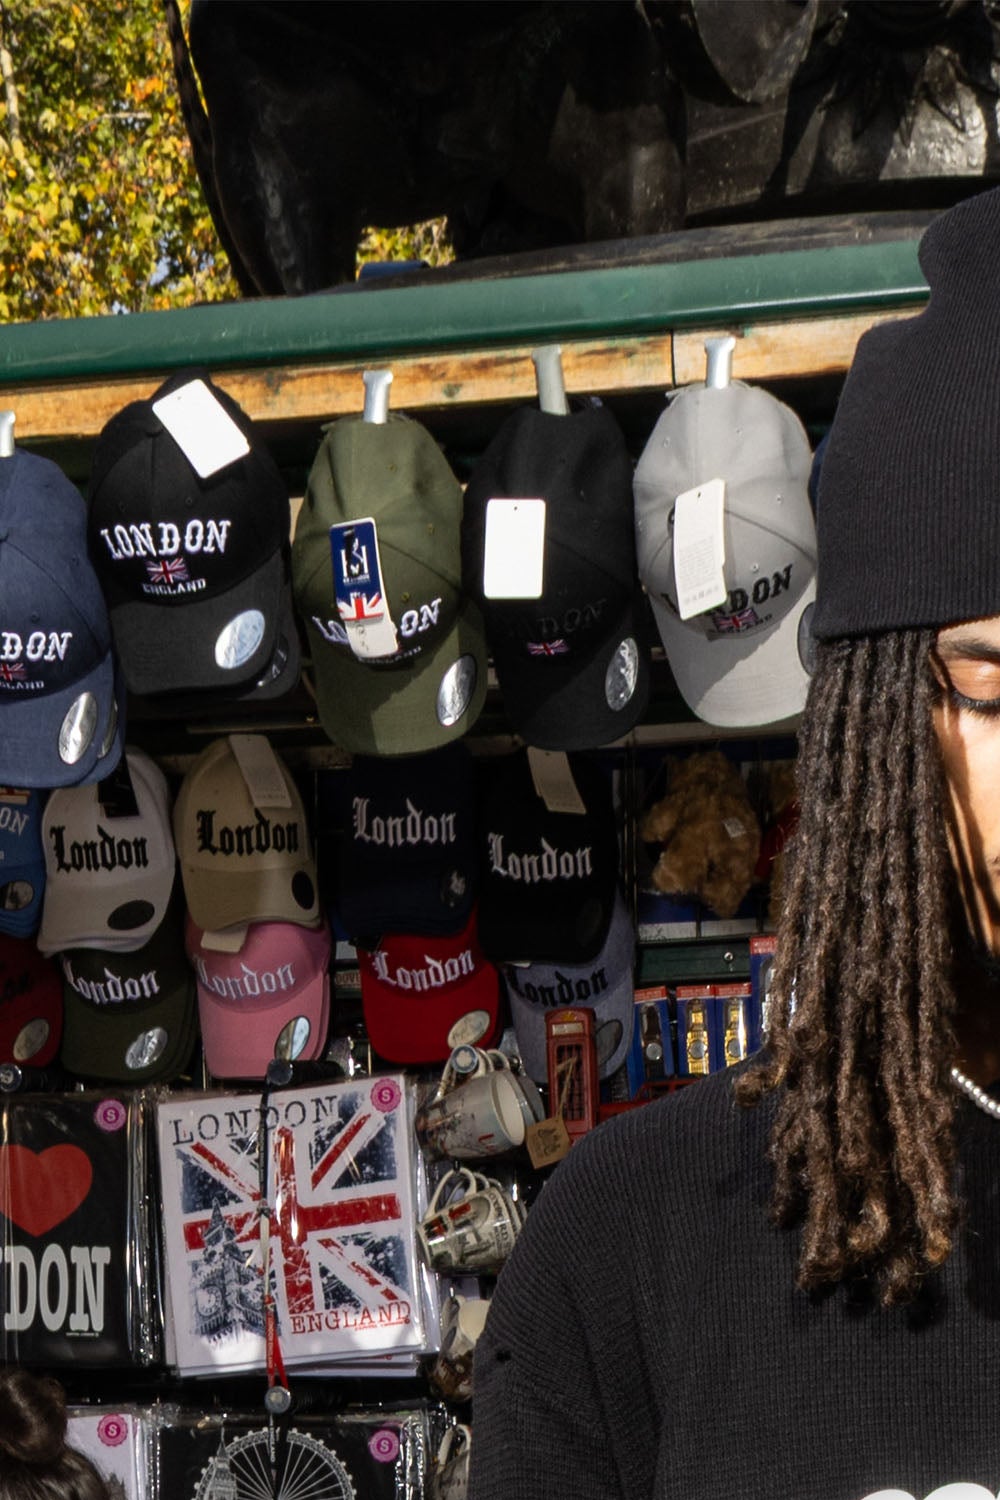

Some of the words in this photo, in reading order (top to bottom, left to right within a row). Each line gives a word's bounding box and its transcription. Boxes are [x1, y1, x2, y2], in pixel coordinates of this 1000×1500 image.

[100, 518, 231, 560] LONDON
[141, 577, 207, 595] ENGLAND
[197, 809, 299, 857] London
[352, 797, 457, 848] London
[51, 824, 149, 873] London
[487, 831, 593, 883] London
[62, 951, 160, 1005] London
[197, 957, 297, 1001] London
[371, 949, 475, 993] London
[171, 1095, 338, 1147] LONDON
[289, 1300, 412, 1335] ENGLAND
